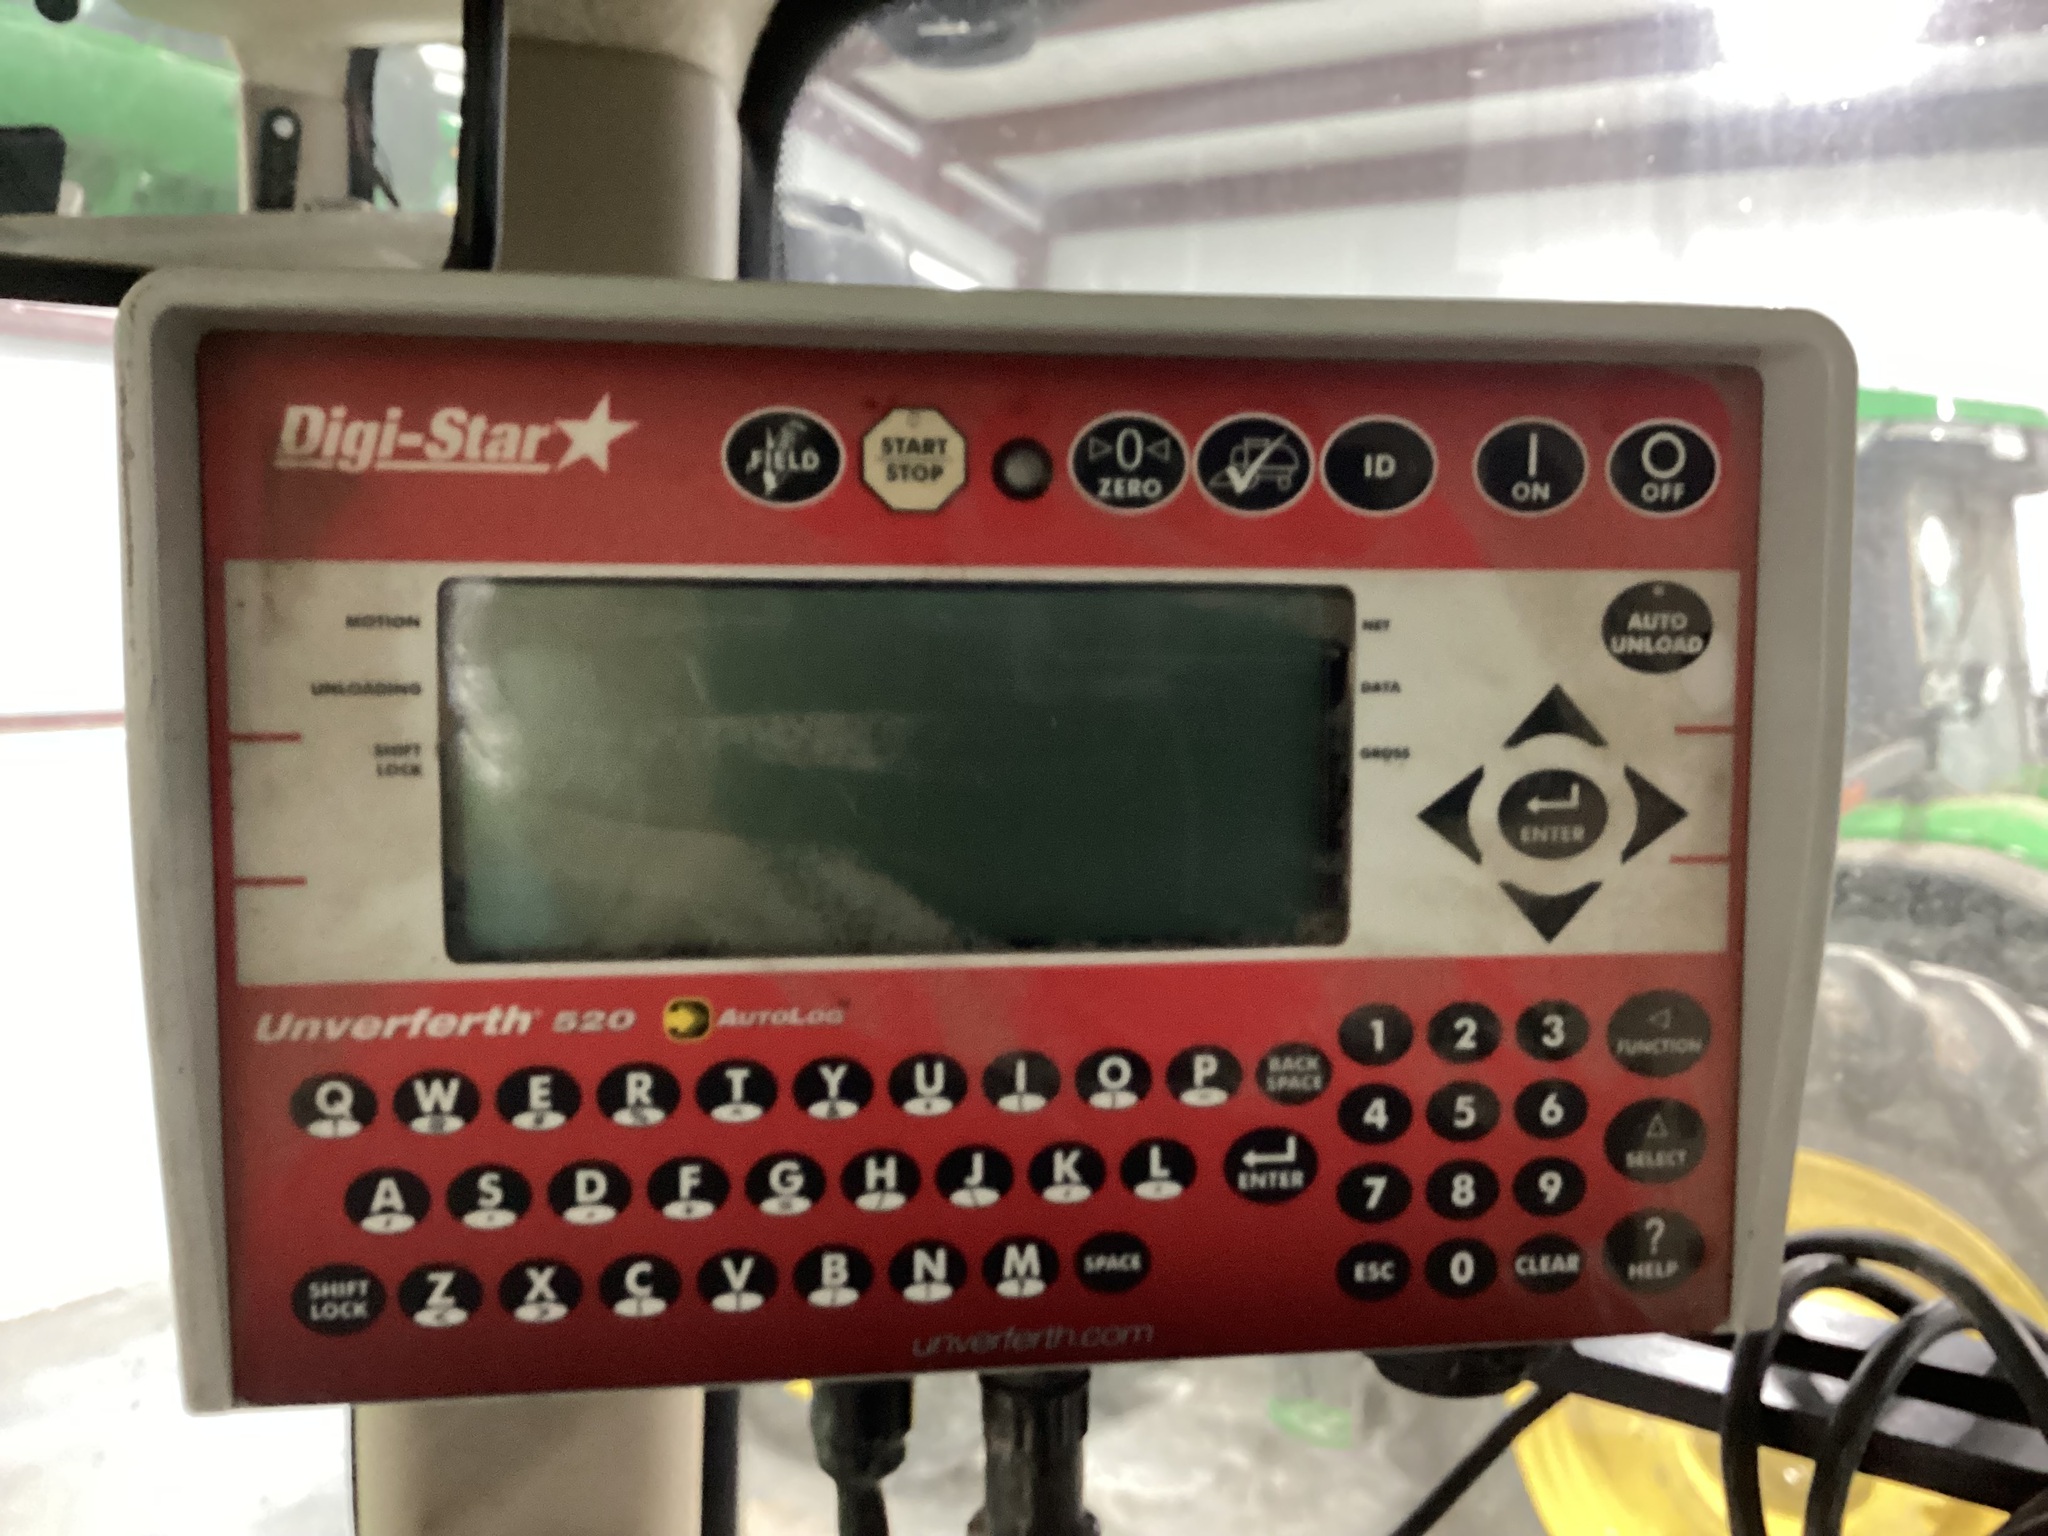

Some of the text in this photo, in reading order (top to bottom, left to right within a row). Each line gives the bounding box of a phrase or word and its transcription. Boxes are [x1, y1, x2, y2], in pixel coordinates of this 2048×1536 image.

[278, 405, 552, 473] Digi-Star
[881, 437, 947, 456] START
[746, 448, 820, 474] FIELD
[886, 464, 943, 483] STOP
[1364, 455, 1396, 479] ID
[1098, 478, 1163, 499] ZERO
[1512, 482, 1551, 502] ON
[1641, 482, 1686, 502] OFF
[1628, 612, 1688, 632] AUTO
[1610, 635, 1703, 654] UNLOAD
[1519, 825, 1586, 844] ENTER
[254, 1004, 637, 1042] Unverferth 520
[1370, 1019, 1385, 1052] 1
[1453, 1017, 1478, 1051] 2
[1541, 1014, 1566, 1048] 3
[1617, 1037, 1703, 1056] FUNCTION
[818, 1064, 848, 1099] Y
[913, 1061, 944, 1097] U
[1015, 1059, 1028, 1093] I
[1096, 1056, 1132, 1091] O
[1192, 1054, 1218, 1087] P
[1266, 1073, 1323, 1092] SPACE
[1269, 1056, 1319, 1075] BACK
[315, 1080, 355, 1118] Q
[413, 1078, 461, 1114] W
[529, 1075, 552, 1109] E
[626, 1071, 655, 1106] R
[724, 1068, 751, 1102] T
[1362, 1097, 1389, 1131] 4
[1452, 1095, 1476, 1129] 5
[1539, 1093, 1564, 1127] 6
[864, 1155, 897, 1192] H
[964, 1152, 985, 1187] J
[1052, 1148, 1082, 1184] K
[1148, 1145, 1171, 1180] L
[1625, 1150, 1687, 1168] SELECT
[475, 1172, 503, 1208] S
[574, 1169, 607, 1204] D
[678, 1164, 701, 1199] F
[769, 1160, 805, 1195] G
[1237, 1170, 1304, 1190] ENTER
[1362, 1175, 1388, 1210] 7
[1450, 1173, 1476, 1207] 8
[1537, 1170, 1563, 1204] 9
[370, 1177, 406, 1213] A
[721, 1256, 755, 1291] V
[820, 1252, 849, 1287] B
[912, 1247, 947, 1283] N
[1002, 1243, 1040, 1279] M
[1084, 1252, 1142, 1273] SPACE
[1353, 1261, 1396, 1283] ESC
[1449, 1250, 1475, 1285] 0
[1514, 1253, 1581, 1276] CLEAR
[1627, 1260, 1679, 1280] HELP
[309, 1279, 371, 1300] SHIFT
[427, 1271, 455, 1307] Z
[525, 1266, 557, 1302] X
[624, 1261, 653, 1297] C
[310, 1301, 369, 1321] LOCK
